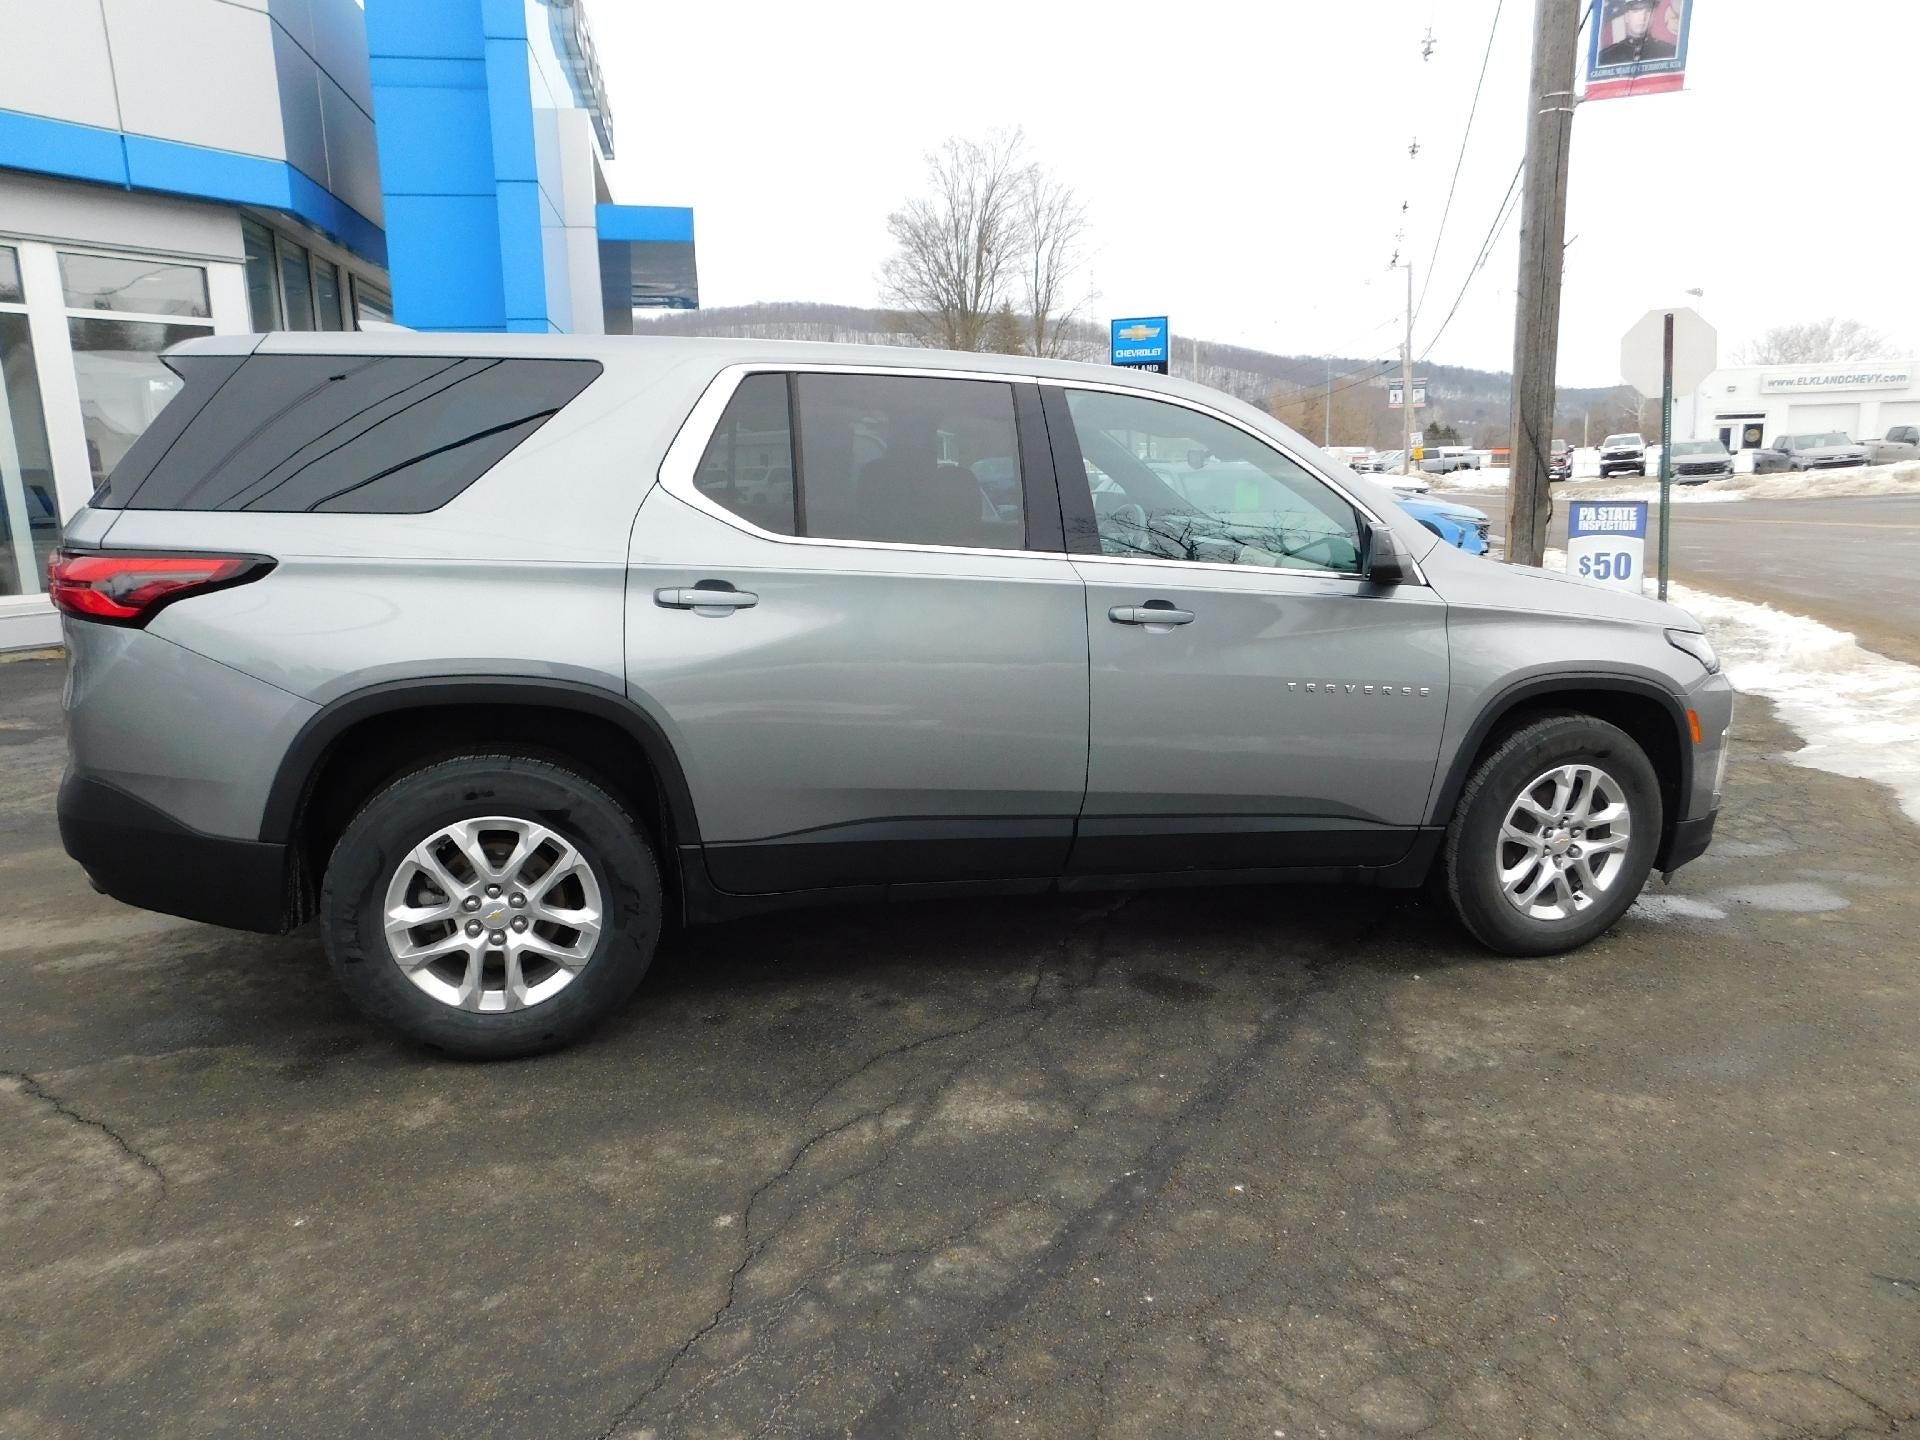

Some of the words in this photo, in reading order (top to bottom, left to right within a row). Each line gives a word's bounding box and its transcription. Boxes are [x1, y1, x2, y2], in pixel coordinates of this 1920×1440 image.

[1115, 347, 1162, 358] CHEVROLET
[1579, 507, 1597, 520] PA
[1597, 507, 1638, 520] STATE
[1578, 520, 1637, 531] INSPECTION
[1578, 552, 1632, 580] $50
[1287, 682, 1430, 697] TRAVERSE
